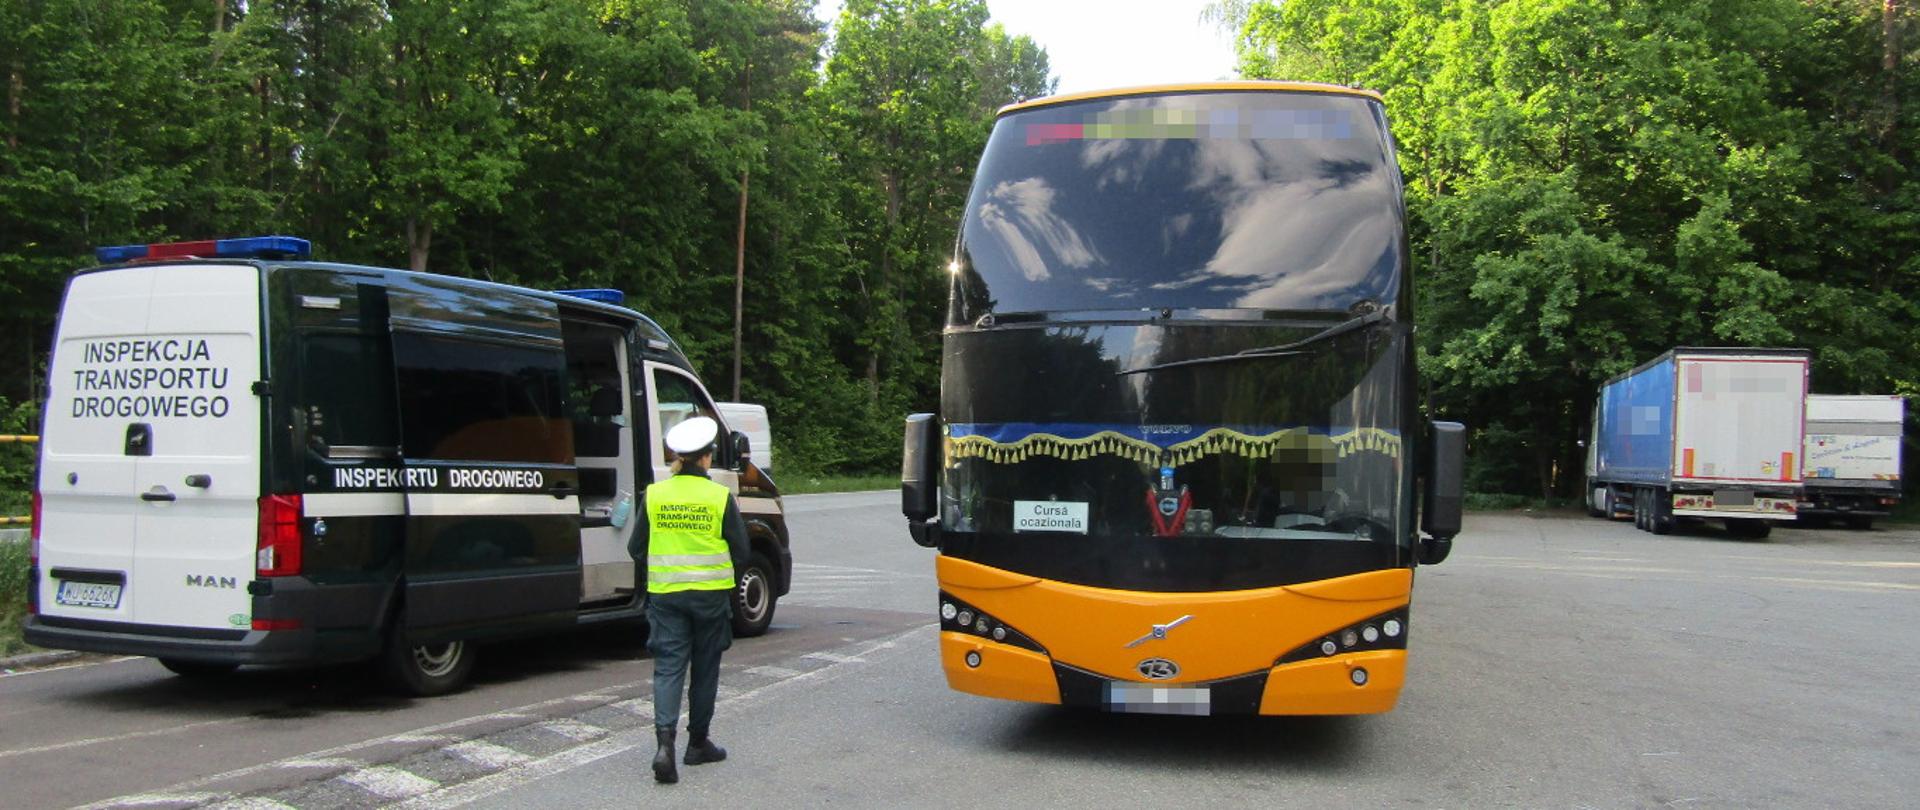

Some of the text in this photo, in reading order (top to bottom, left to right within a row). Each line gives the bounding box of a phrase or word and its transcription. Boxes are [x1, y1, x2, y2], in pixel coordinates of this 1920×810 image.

[84, 340, 210, 363] INSPEKCJA
[73, 367, 229, 390] TRANSPORTU
[72, 396, 229, 418] DROGOWEGO
[449, 469, 544, 488] DROGOWEGO
[656, 522, 712, 531] DROGOWEGO
[657, 513, 713, 522] TRANSPORTU
[186, 574, 236, 589] MAN
